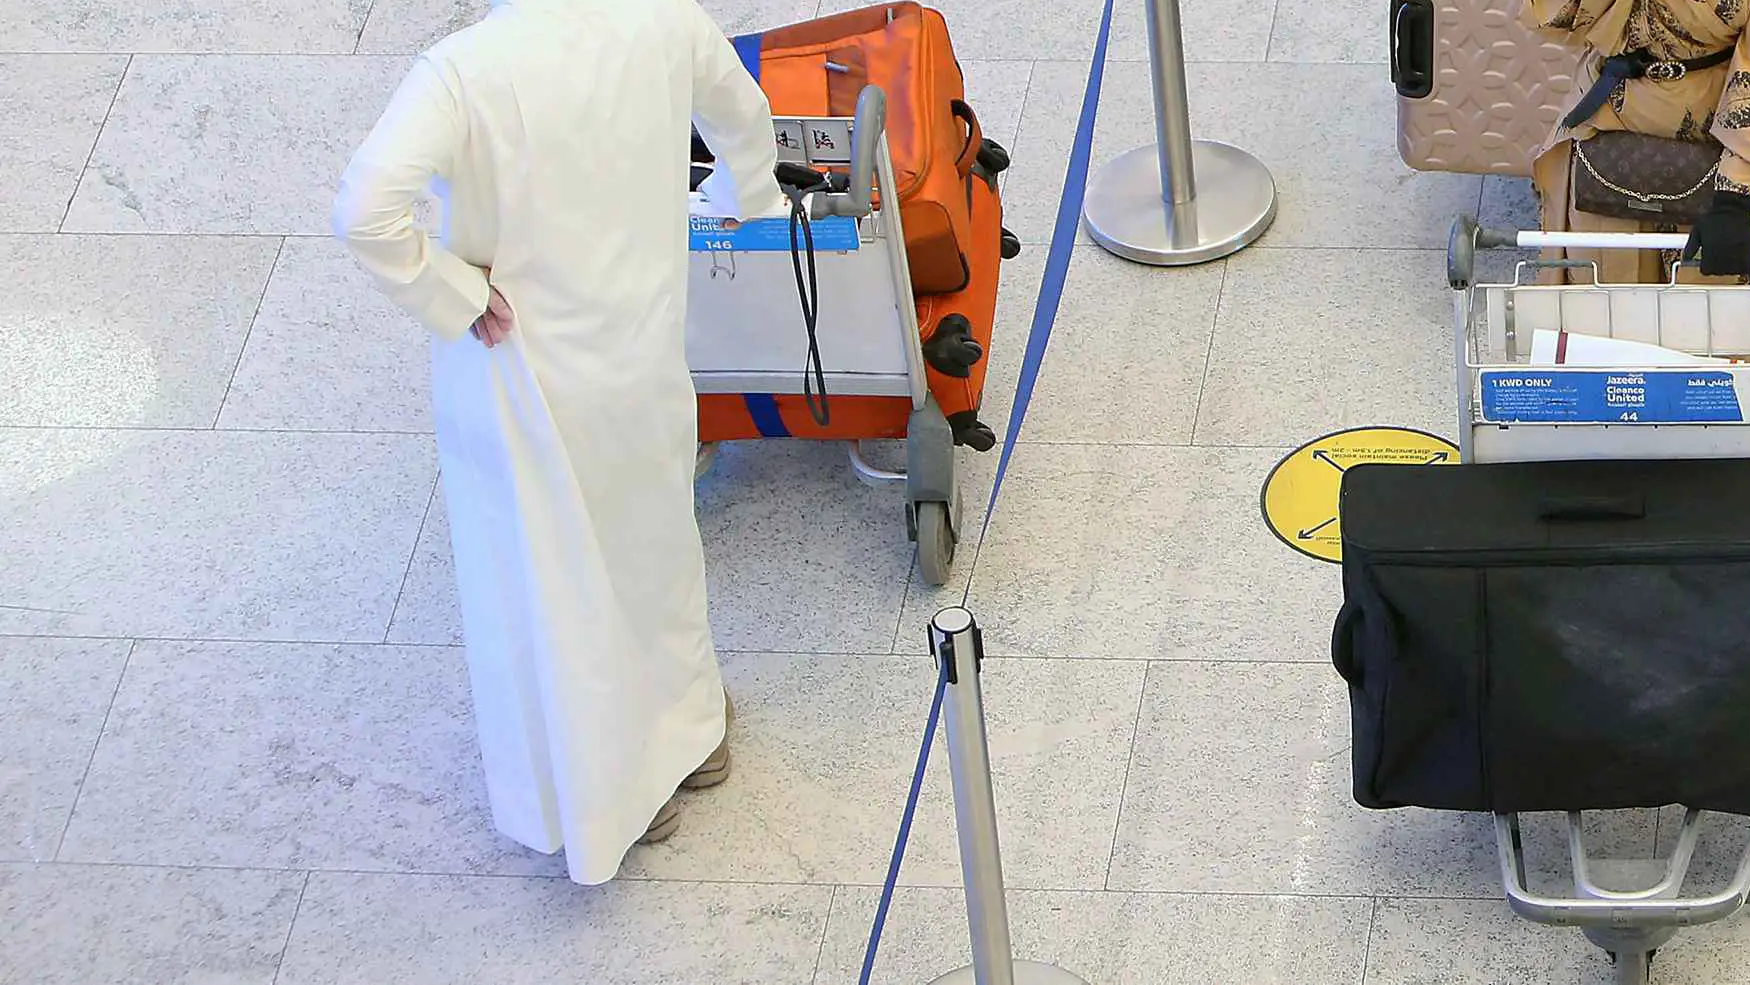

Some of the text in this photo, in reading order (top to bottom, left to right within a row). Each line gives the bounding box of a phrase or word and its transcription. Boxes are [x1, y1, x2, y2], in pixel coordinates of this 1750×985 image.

[690, 216, 720, 224] Clean
[705, 240, 733, 249] 146
[1492, 378, 1552, 387] 1 KWD ONLY
[1606, 386, 1645, 394] Cleanco
[1607, 394, 1645, 402] United
[1619, 412, 1638, 421] 44
